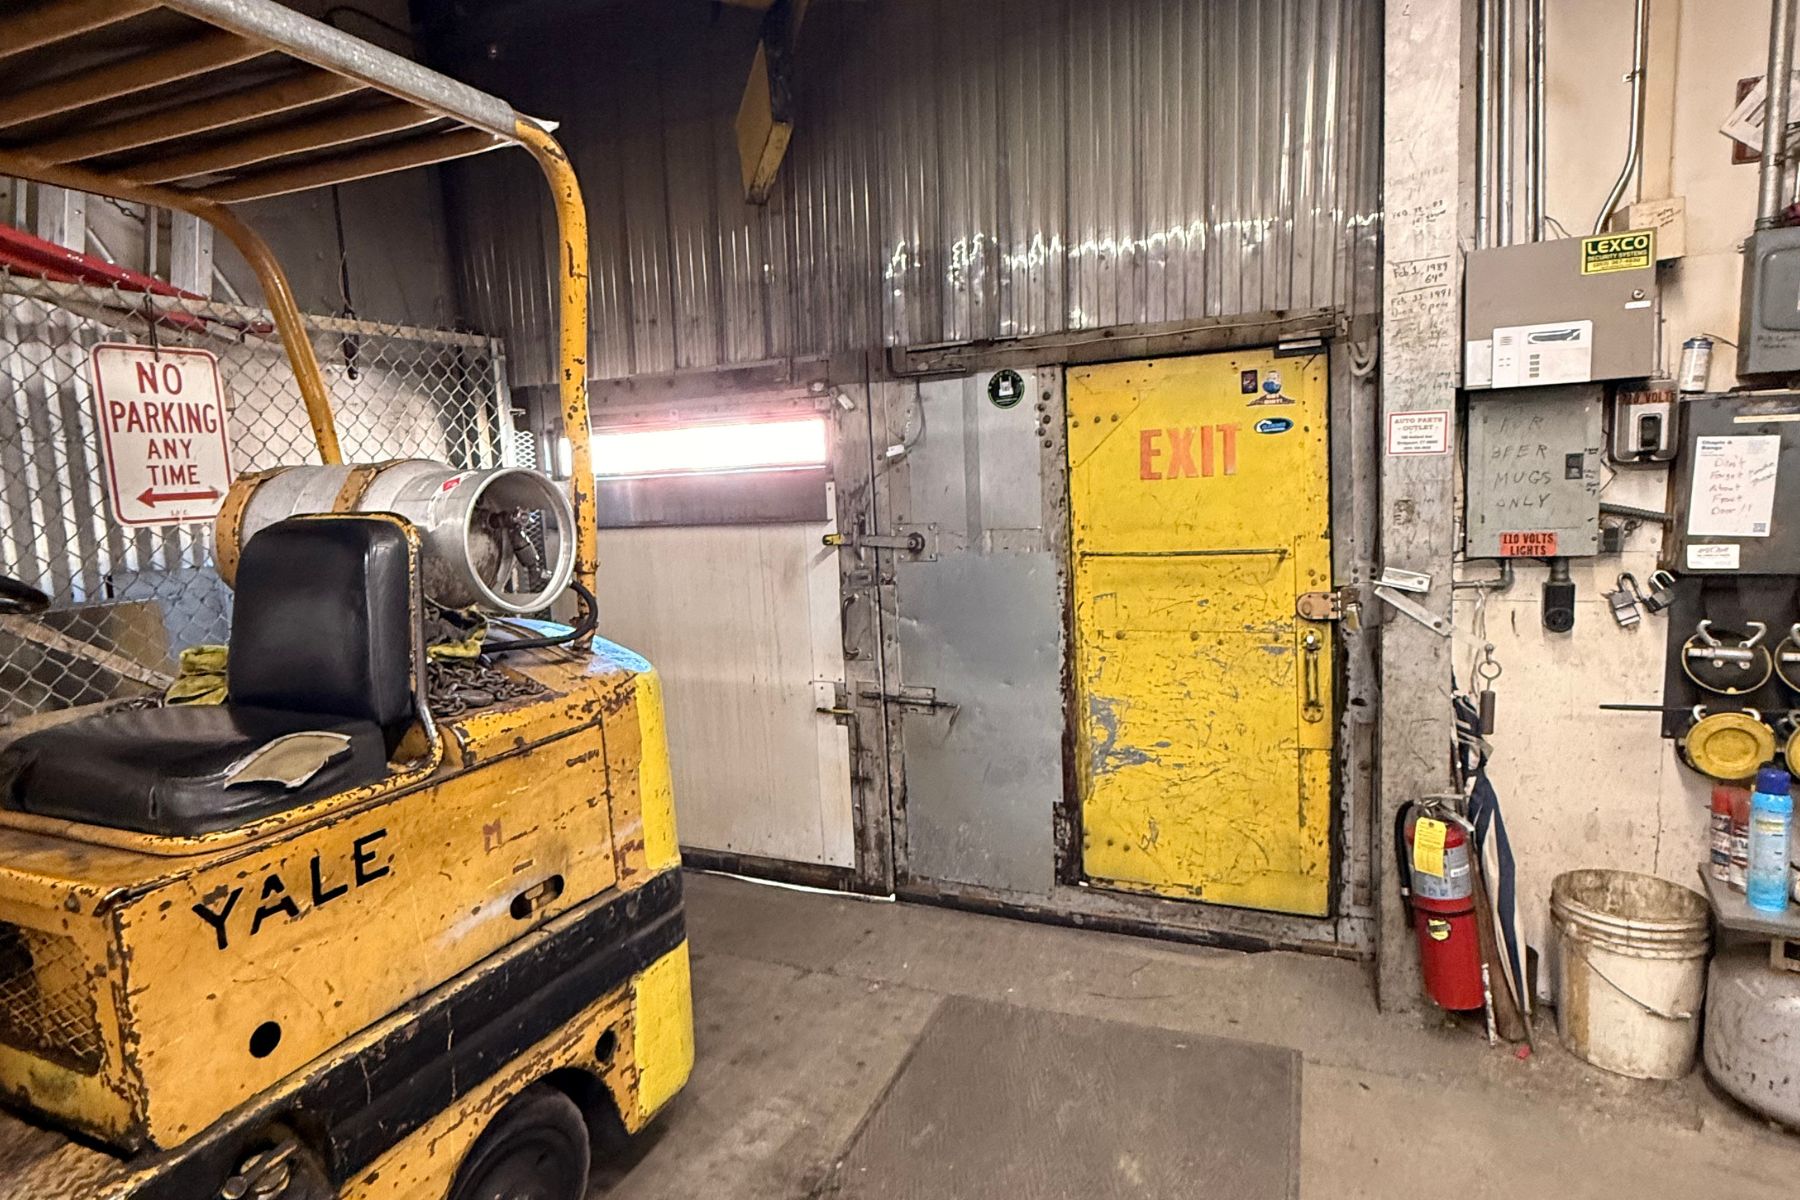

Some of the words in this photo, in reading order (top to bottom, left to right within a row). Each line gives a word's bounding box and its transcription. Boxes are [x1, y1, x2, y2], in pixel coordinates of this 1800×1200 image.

[1587, 236, 1648, 255] LEXCO
[1587, 252, 1617, 262] SECURITY
[1619, 248, 1648, 259] SYSTEMS
[135, 361, 183, 395] NO
[109, 400, 217, 434] PARKING
[147, 438, 192, 460] ANY
[1139, 423, 1241, 481] EXIT
[146, 464, 200, 486] TIME
[1494, 470, 1551, 489] MUGS
[1496, 493, 1551, 509] ONLY
[1503, 534, 1520, 544] 110
[1523, 533, 1554, 544] VOLTS
[1510, 546, 1547, 556] LIGHTS
[191, 828, 390, 951] YALE
